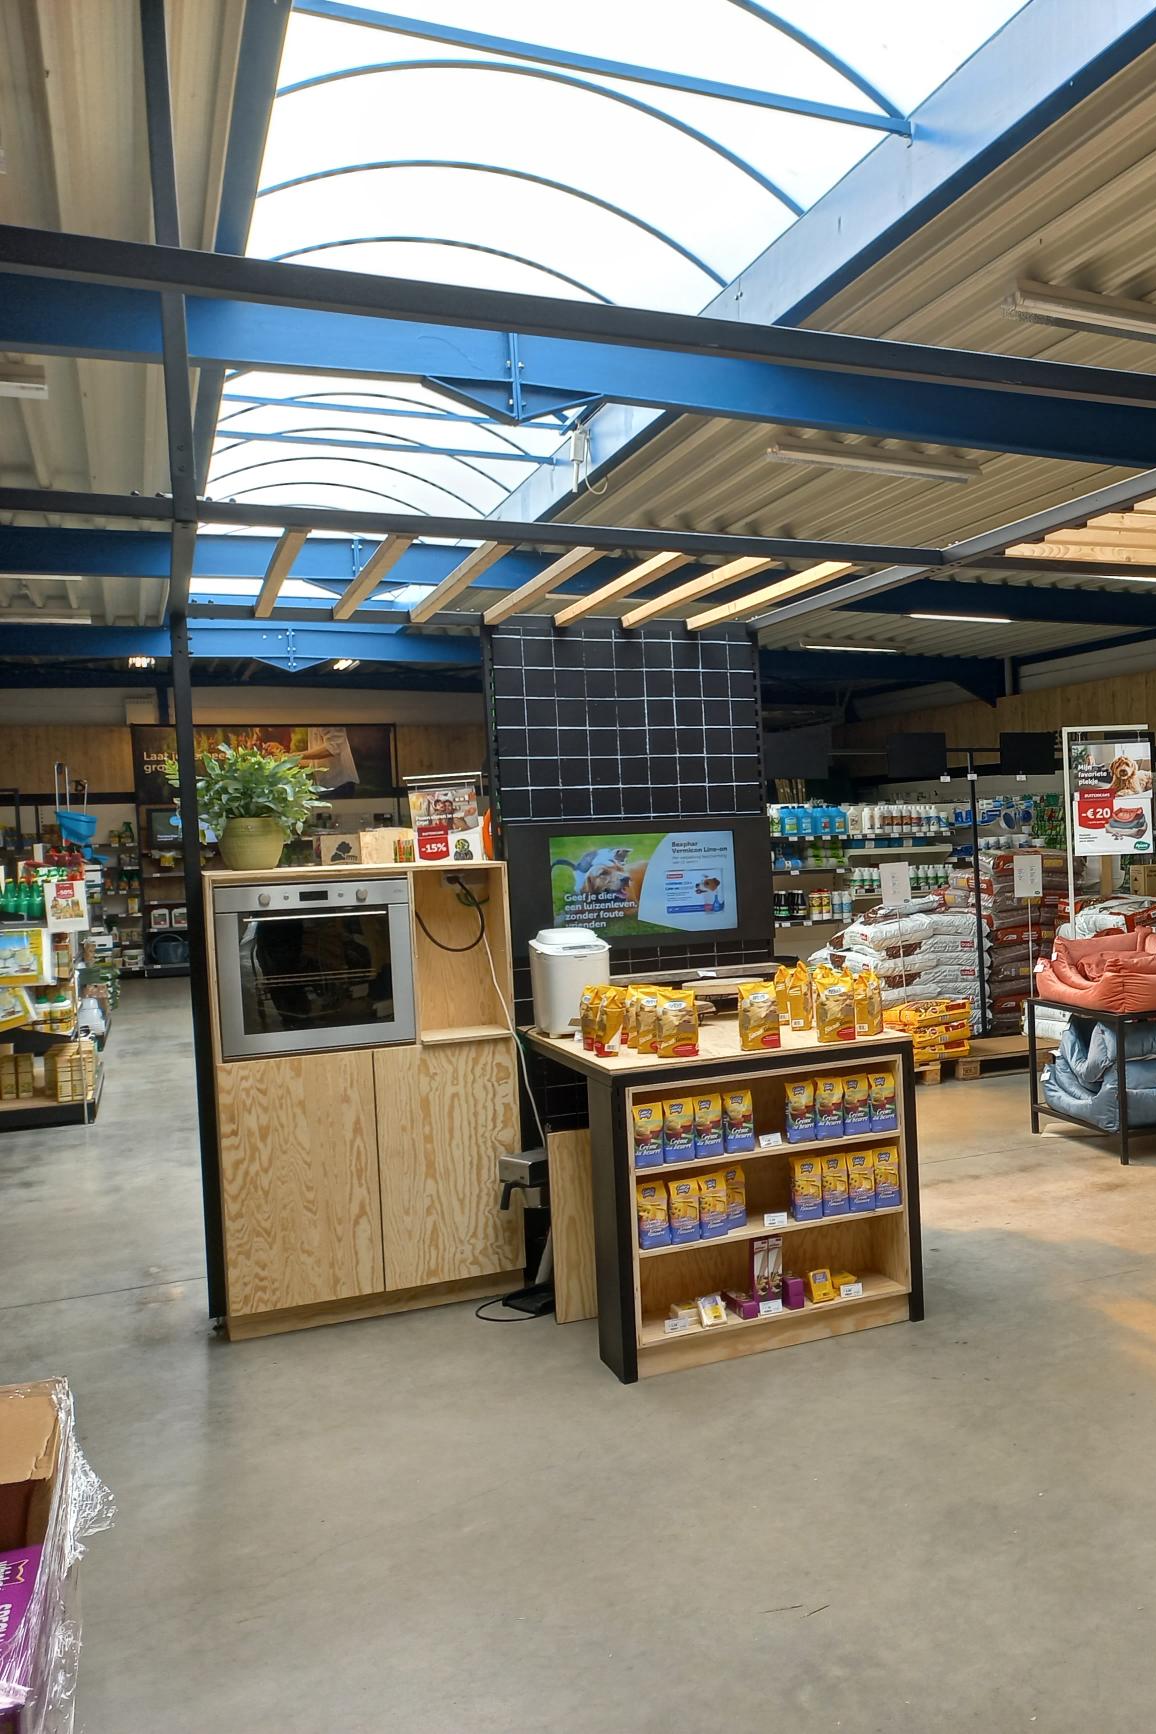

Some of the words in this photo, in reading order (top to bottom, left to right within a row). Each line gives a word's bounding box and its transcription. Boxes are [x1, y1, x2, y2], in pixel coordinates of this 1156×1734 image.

[1096, 808, 1110, 818] 20
[422, 843, 446, 852] -15%
[564, 893, 586, 901] Geef
[588, 892, 597, 902] je
[566, 912, 598, 920] zonder
[600, 910, 624, 918] foute
